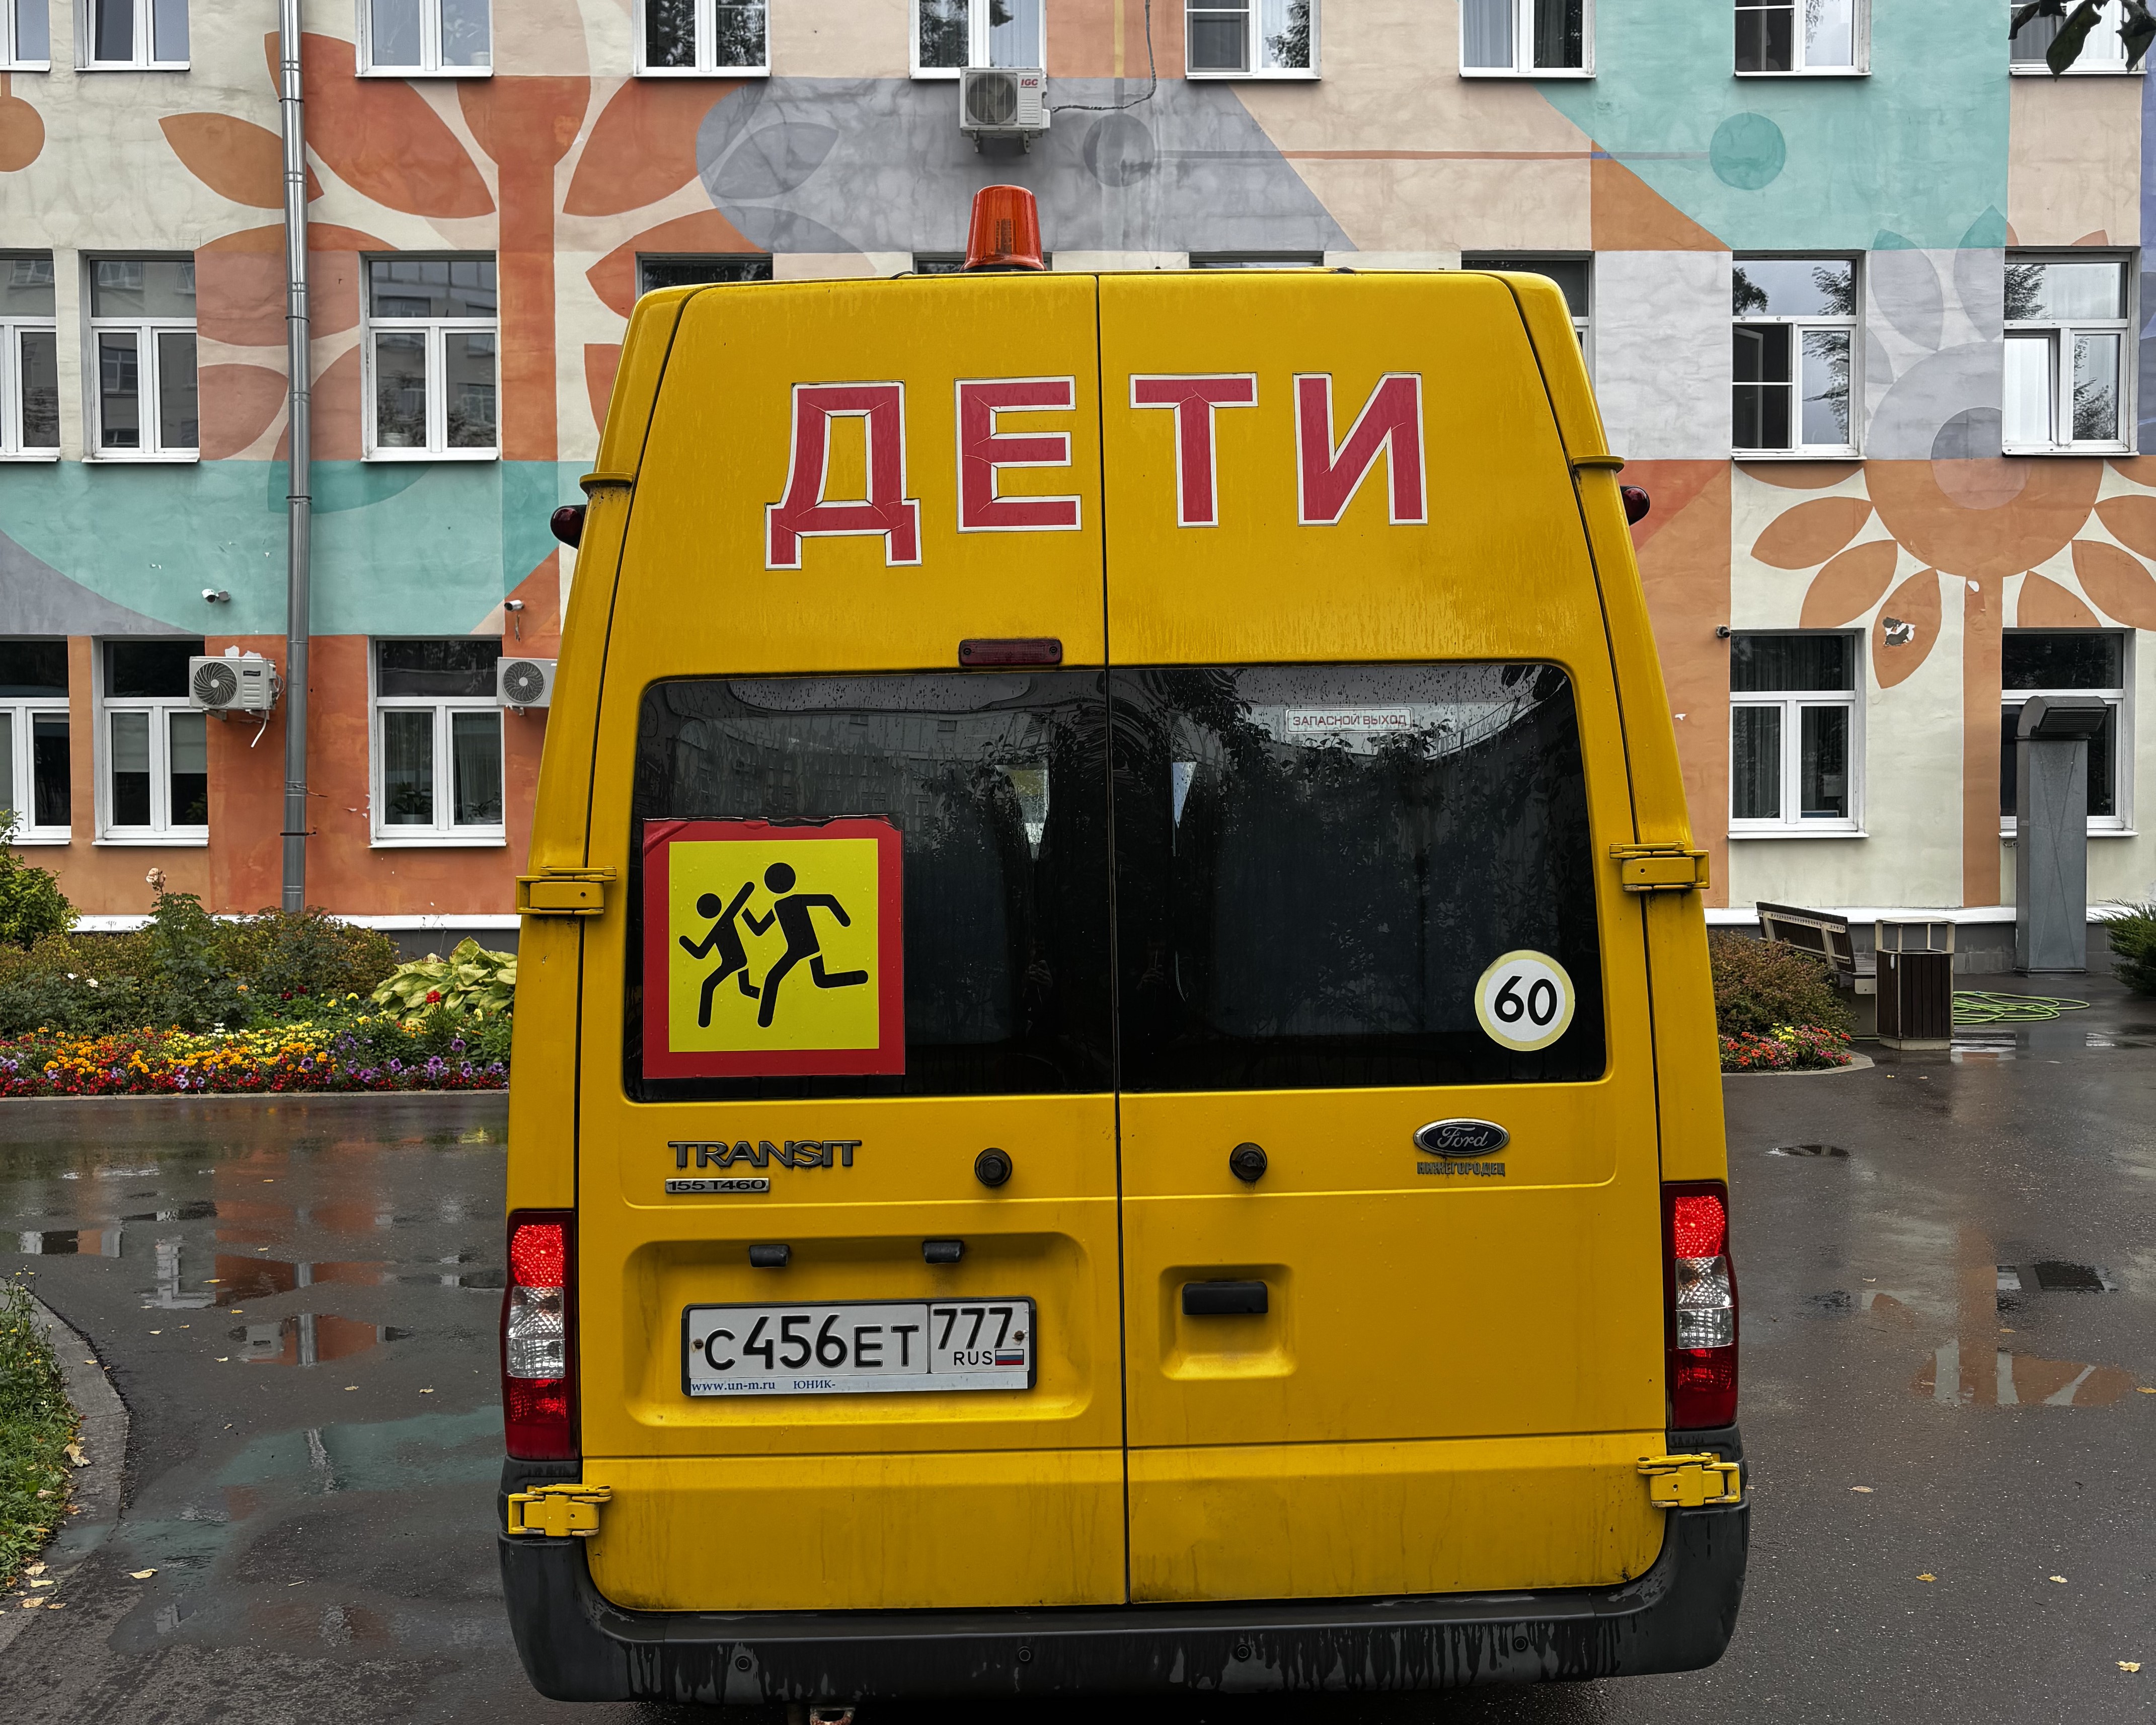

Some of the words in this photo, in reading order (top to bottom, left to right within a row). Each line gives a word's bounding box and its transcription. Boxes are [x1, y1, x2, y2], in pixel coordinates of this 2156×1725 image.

[765, 372, 1428, 570] ДЕТИ
[1292, 713, 1360, 726] ЗАПАСНОЙ
[1362, 715, 1407, 726] ВЫХОД
[1494, 975, 1558, 1026] 60
[1437, 1127, 1489, 1148] Ford
[667, 1140, 862, 1167] TRANSIT
[1417, 1162, 1506, 1177] НИЖЕГОРОДЕЦ
[668, 1180, 705, 1191] 155
[710, 1179, 766, 1190] T460
[933, 1307, 1014, 1350] 777
[953, 1351, 993, 1366] RUS
[692, 1381, 776, 1391] www.un-m.ru
